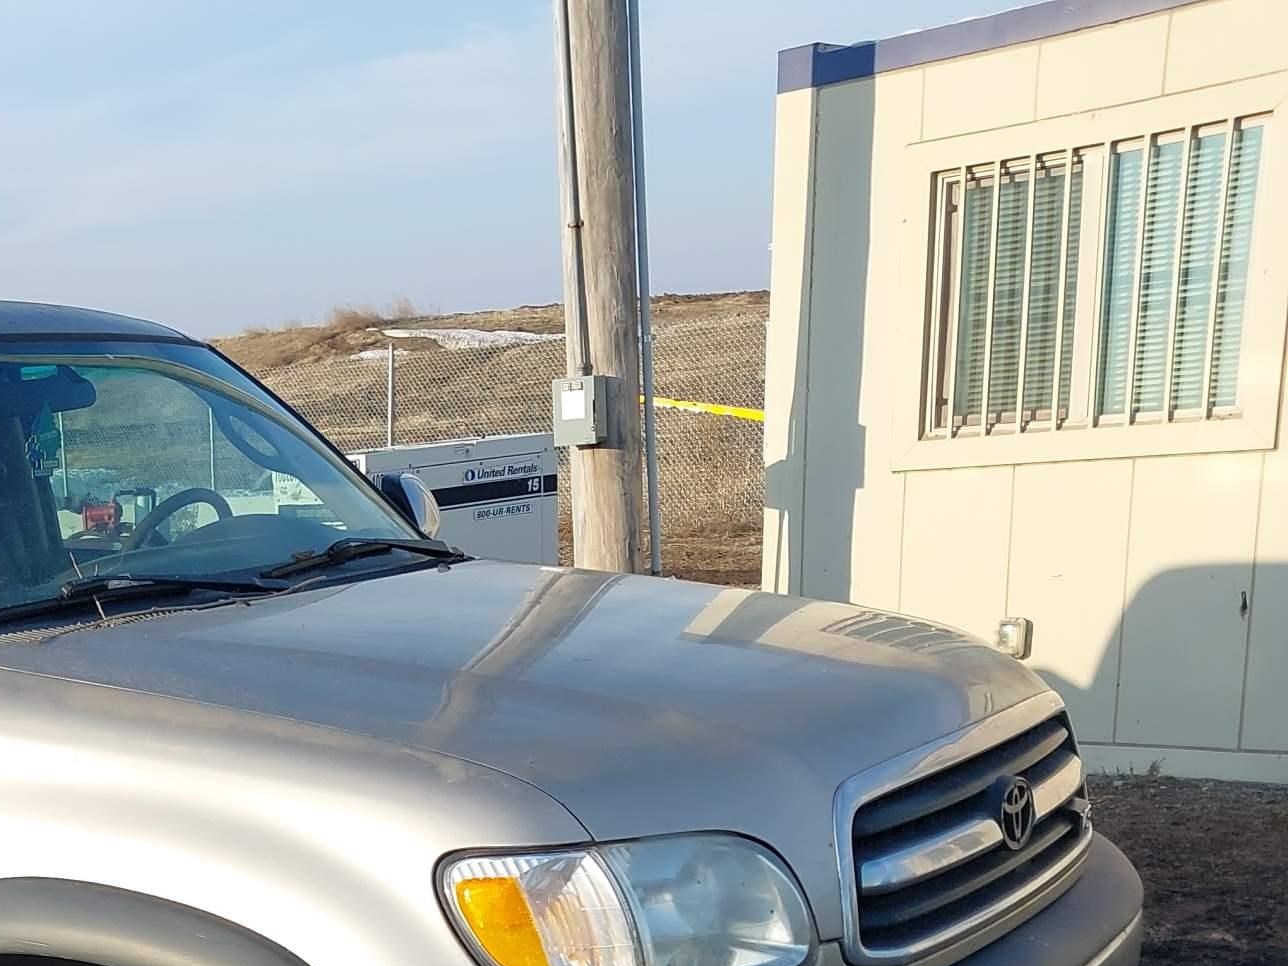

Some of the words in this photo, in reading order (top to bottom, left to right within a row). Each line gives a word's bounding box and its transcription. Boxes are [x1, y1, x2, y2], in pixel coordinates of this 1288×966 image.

[477, 467, 505, 479] United
[507, 464, 538, 475] Rentals
[527, 477, 540, 492] 15
